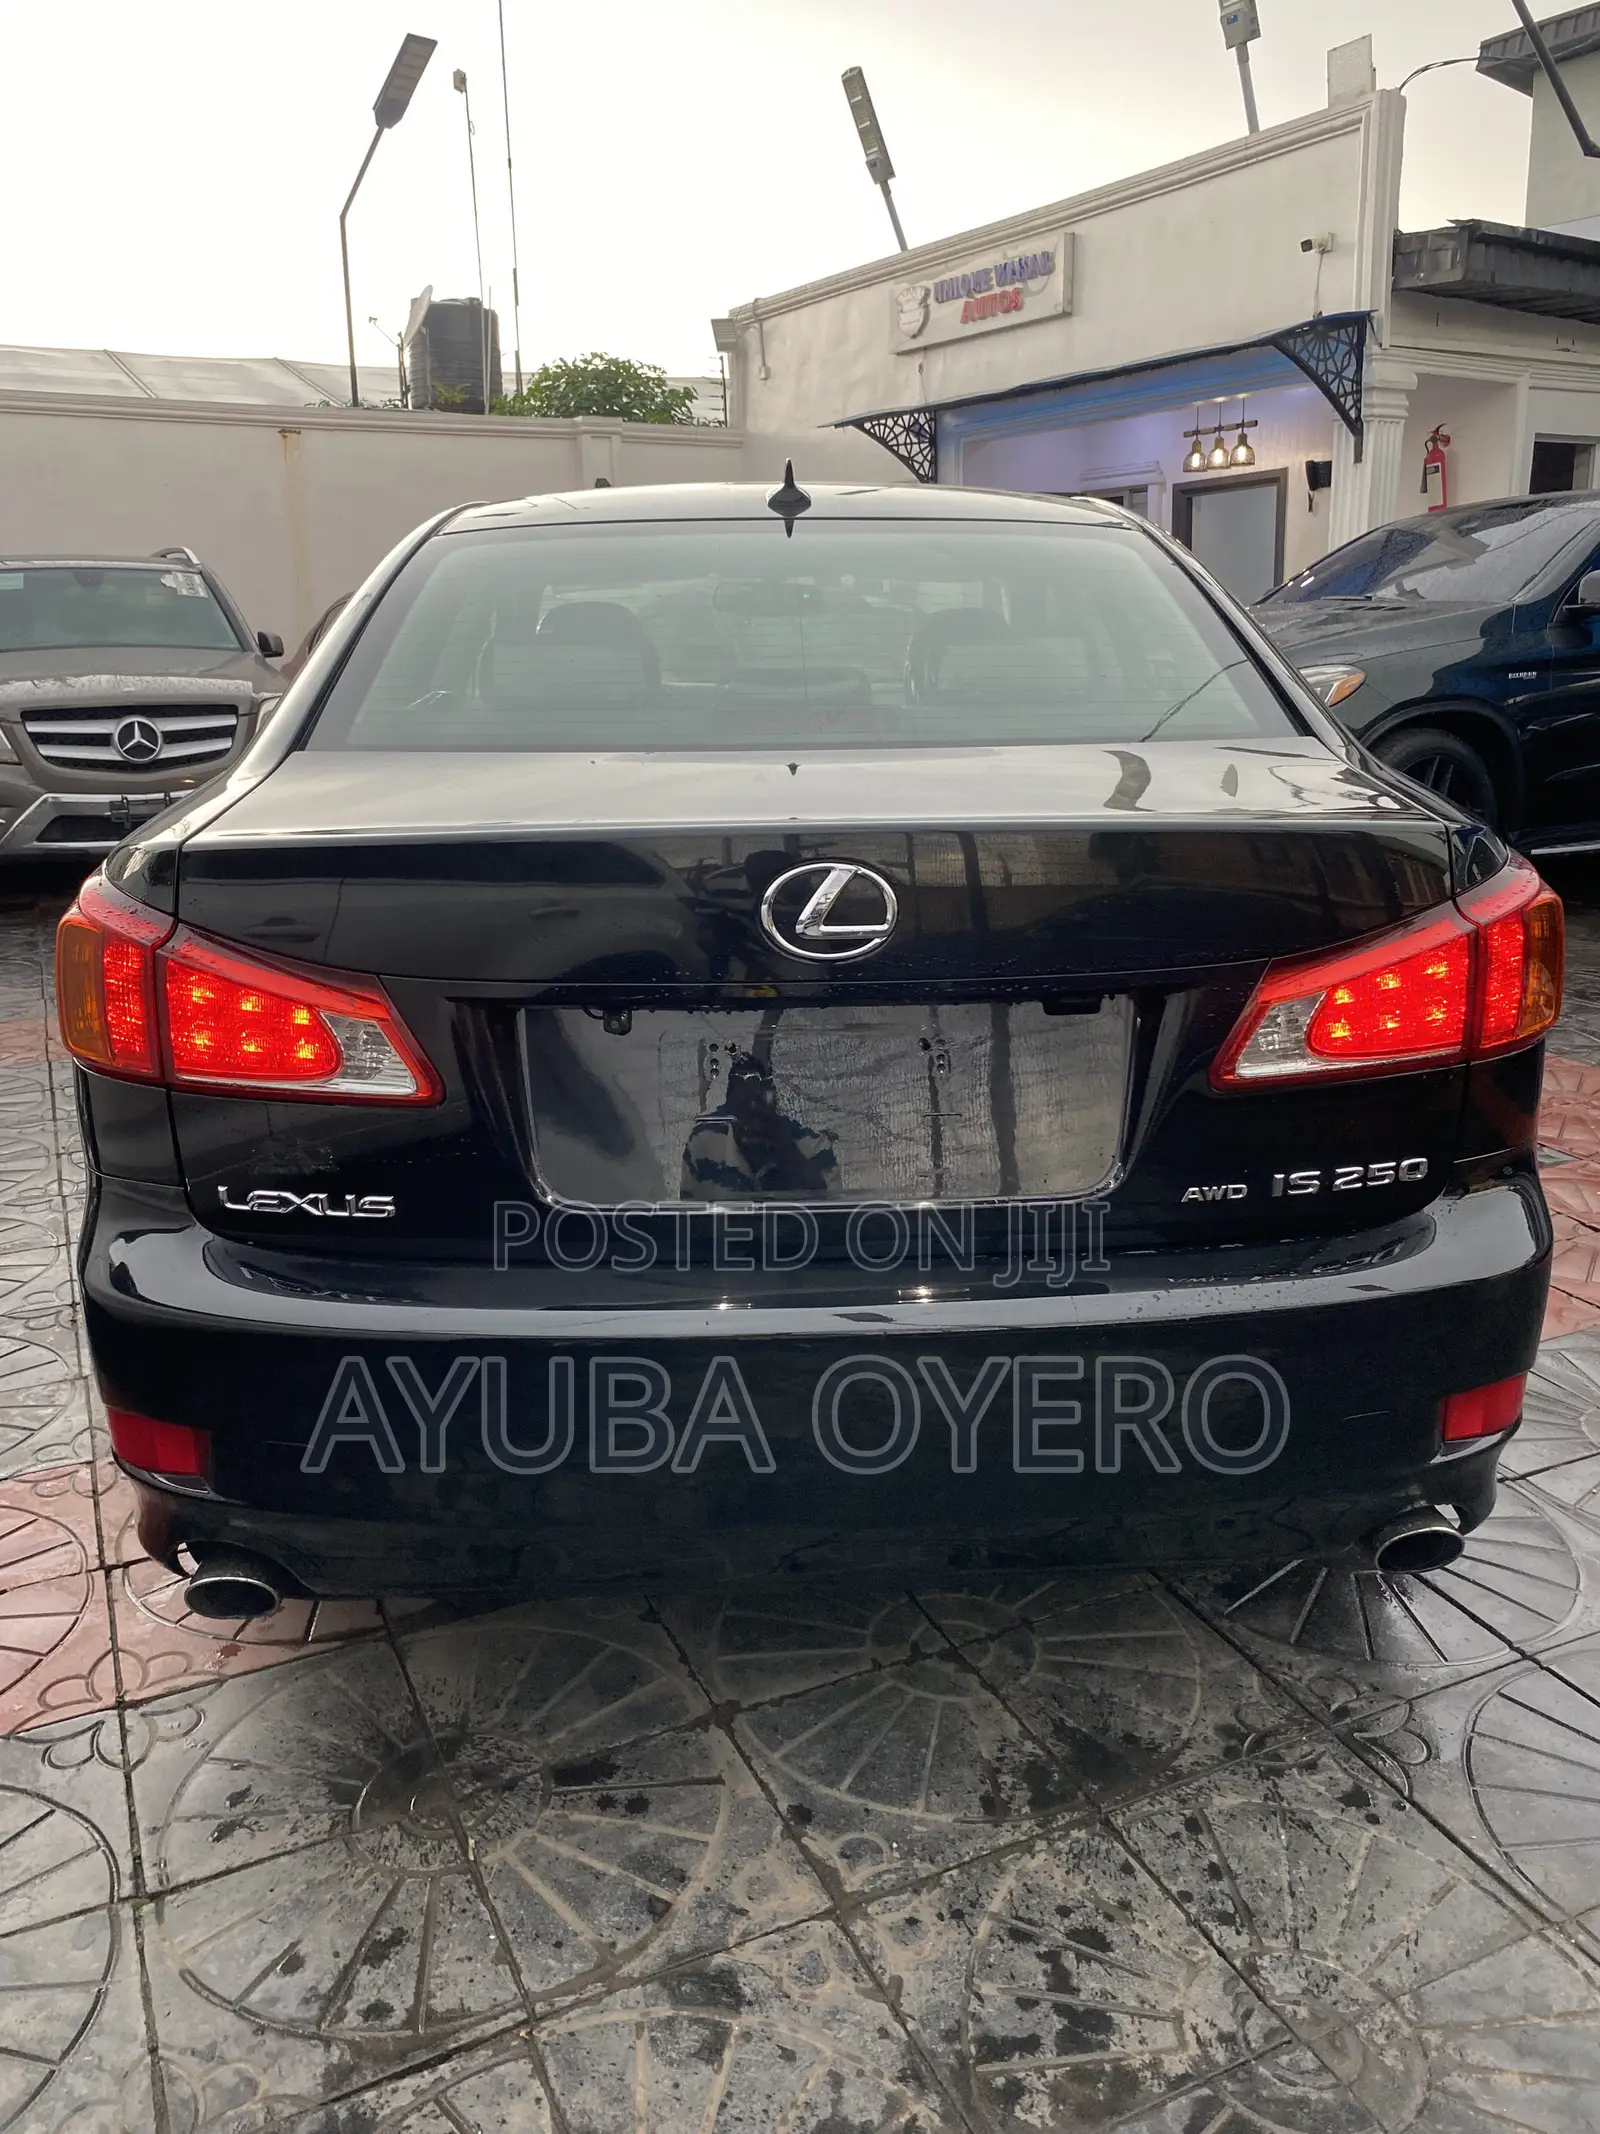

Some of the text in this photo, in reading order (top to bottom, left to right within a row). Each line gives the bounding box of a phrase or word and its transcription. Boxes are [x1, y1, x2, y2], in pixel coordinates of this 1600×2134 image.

[933, 267, 995, 304] UNIQUE
[960, 287, 1023, 324] AUTOS
[1180, 1184, 1248, 1203] AWD
[1271, 1157, 1429, 1198] IS 250
[217, 1185, 396, 1218] LEXUS
